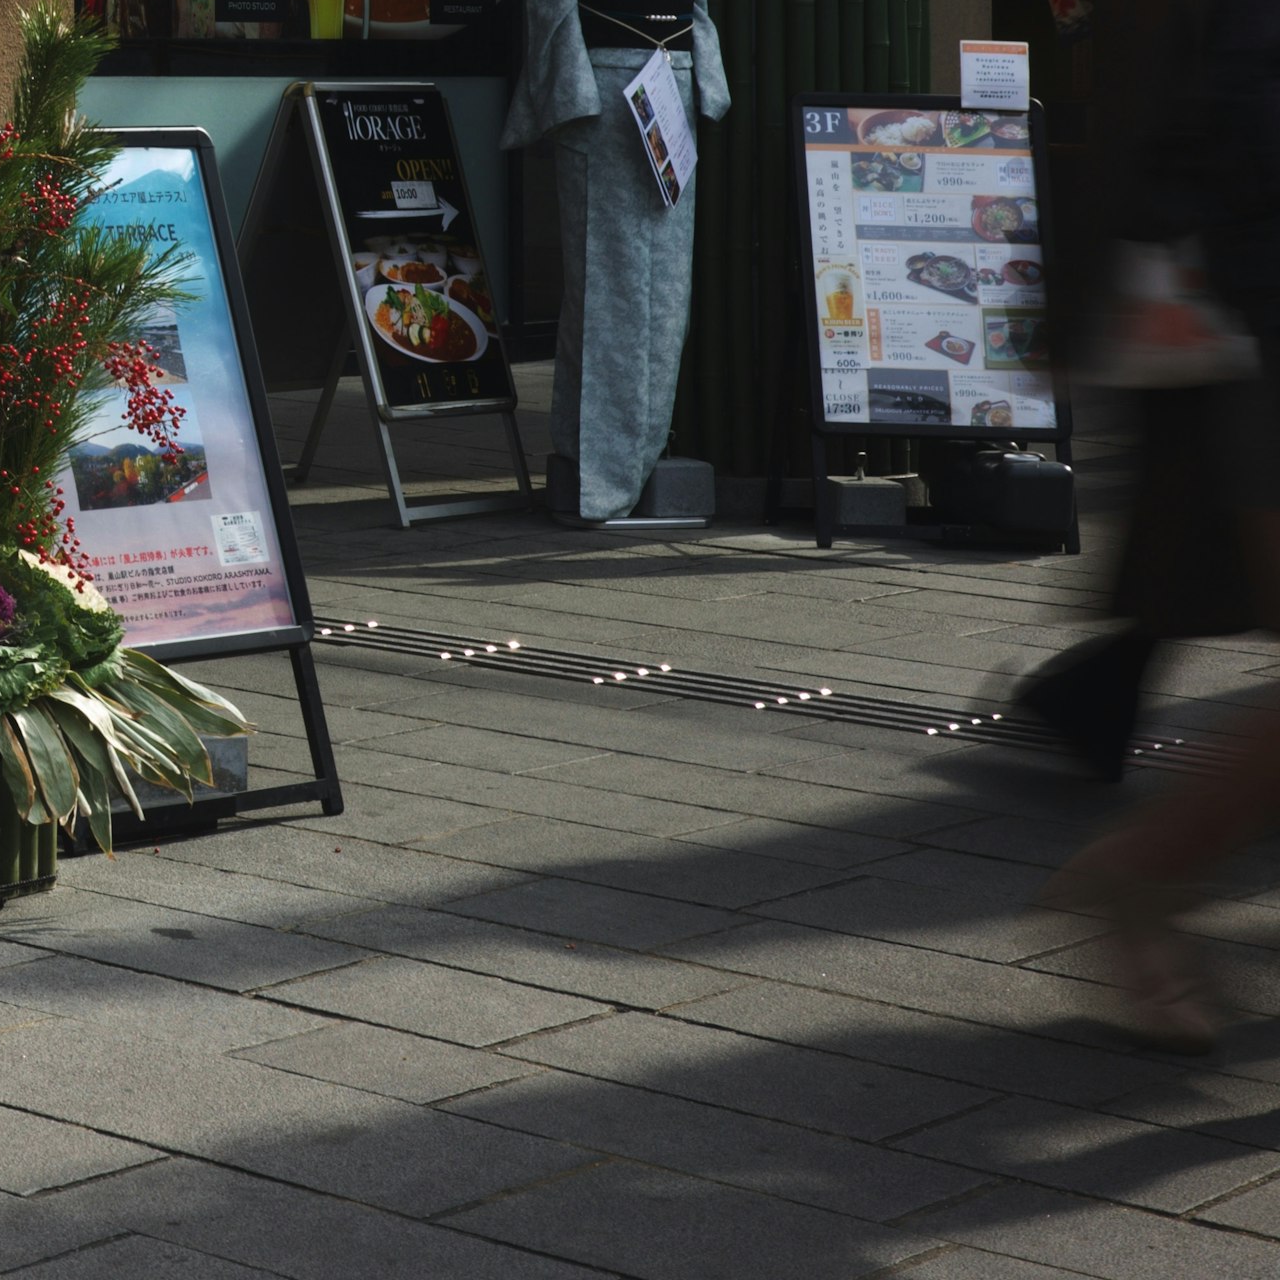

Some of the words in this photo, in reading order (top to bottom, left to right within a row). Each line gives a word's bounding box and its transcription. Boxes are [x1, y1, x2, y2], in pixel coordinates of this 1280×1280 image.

[228, 0, 252, 11] PHOTO
[252, 1, 277, 11] STUDIO
[443, 5, 483, 16] RESTAURANT
[356, 114, 427, 141] ORAGE
[805, 111, 841, 134] 3F
[395, 158, 455, 181] OPEN!!
[937, 176, 963, 187] ¥990
[396, 188, 418, 199] 10:00
[830, 160, 845, 249] 嵐山を一望できる
[873, 201, 894, 209] RICE
[907, 213, 946, 224] ¥1,200
[866, 291, 903, 301] ¥1,600
[887, 352, 912, 361] ¥900
[826, 393, 860, 402] CLOSE
[826, 403, 861, 415] 17:30
[166, 576, 192, 586] STUDIO
[193, 573, 223, 583] KOKORO
